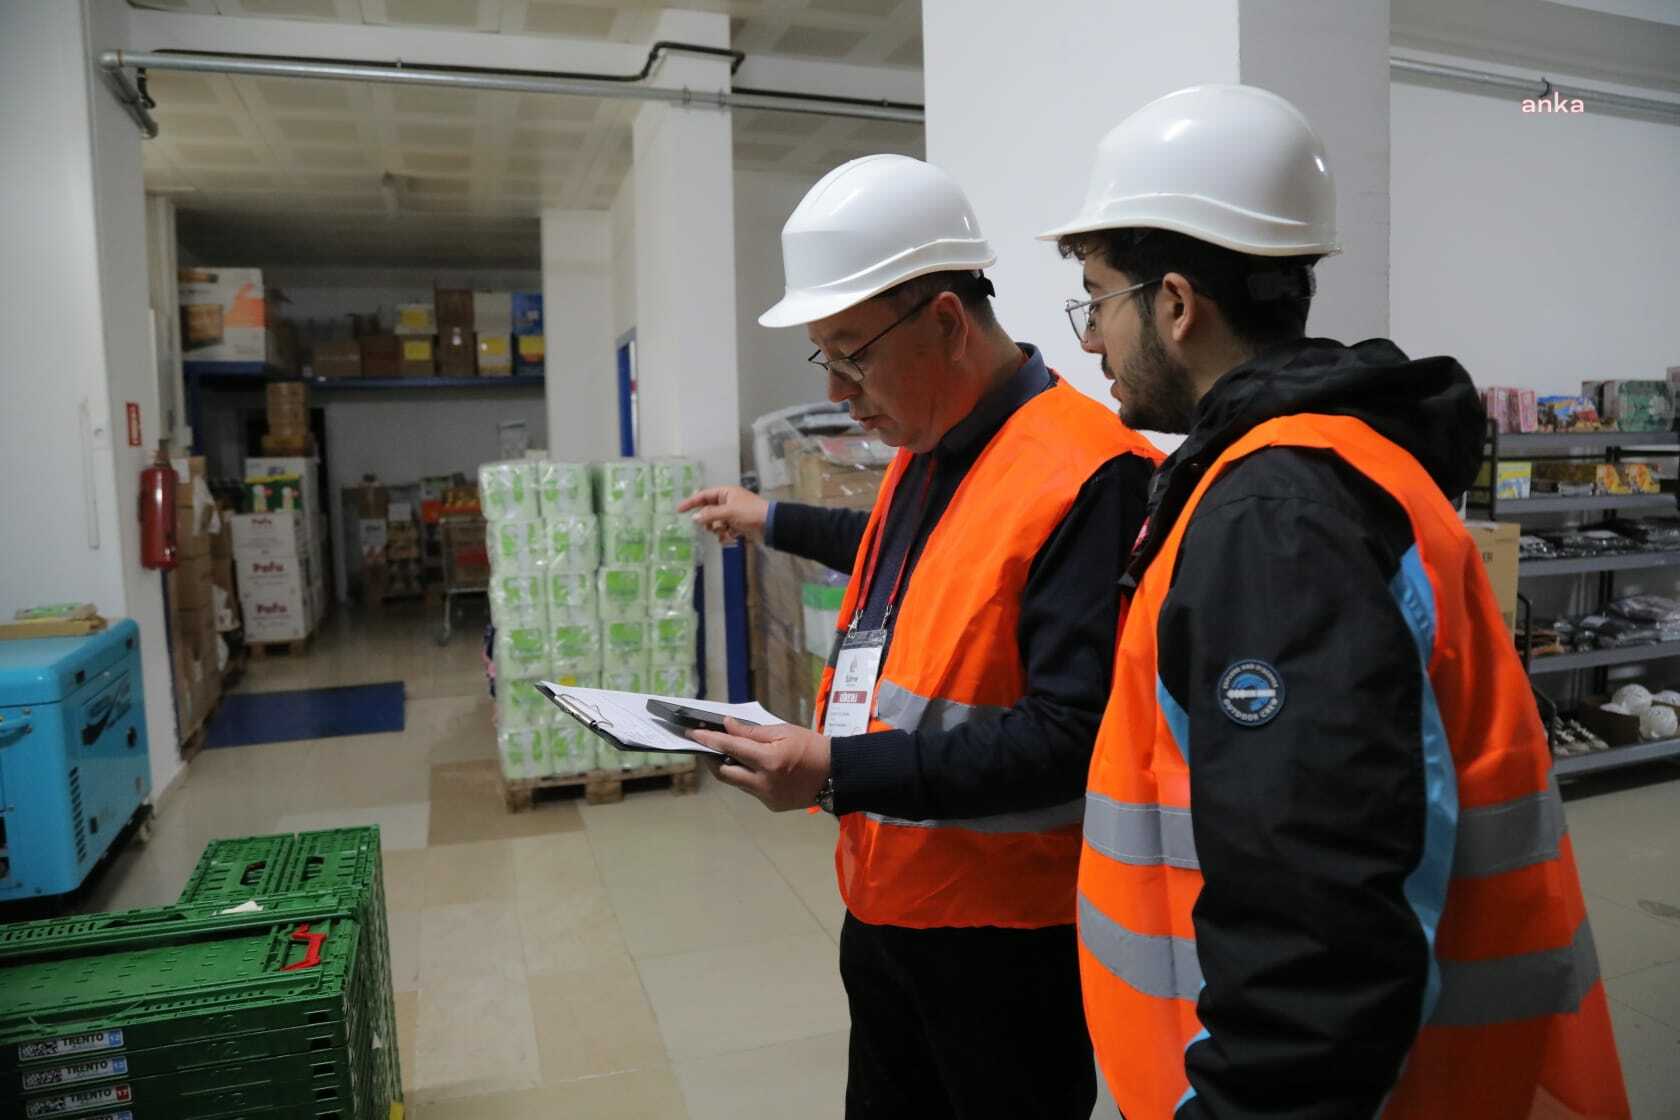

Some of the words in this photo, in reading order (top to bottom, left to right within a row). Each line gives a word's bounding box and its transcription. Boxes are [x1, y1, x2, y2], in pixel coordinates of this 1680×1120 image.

[63, 1032, 104, 1046] TRENTO
[66, 1060, 108, 1074] TRENTO
[71, 1087, 112, 1102] TRENTO
